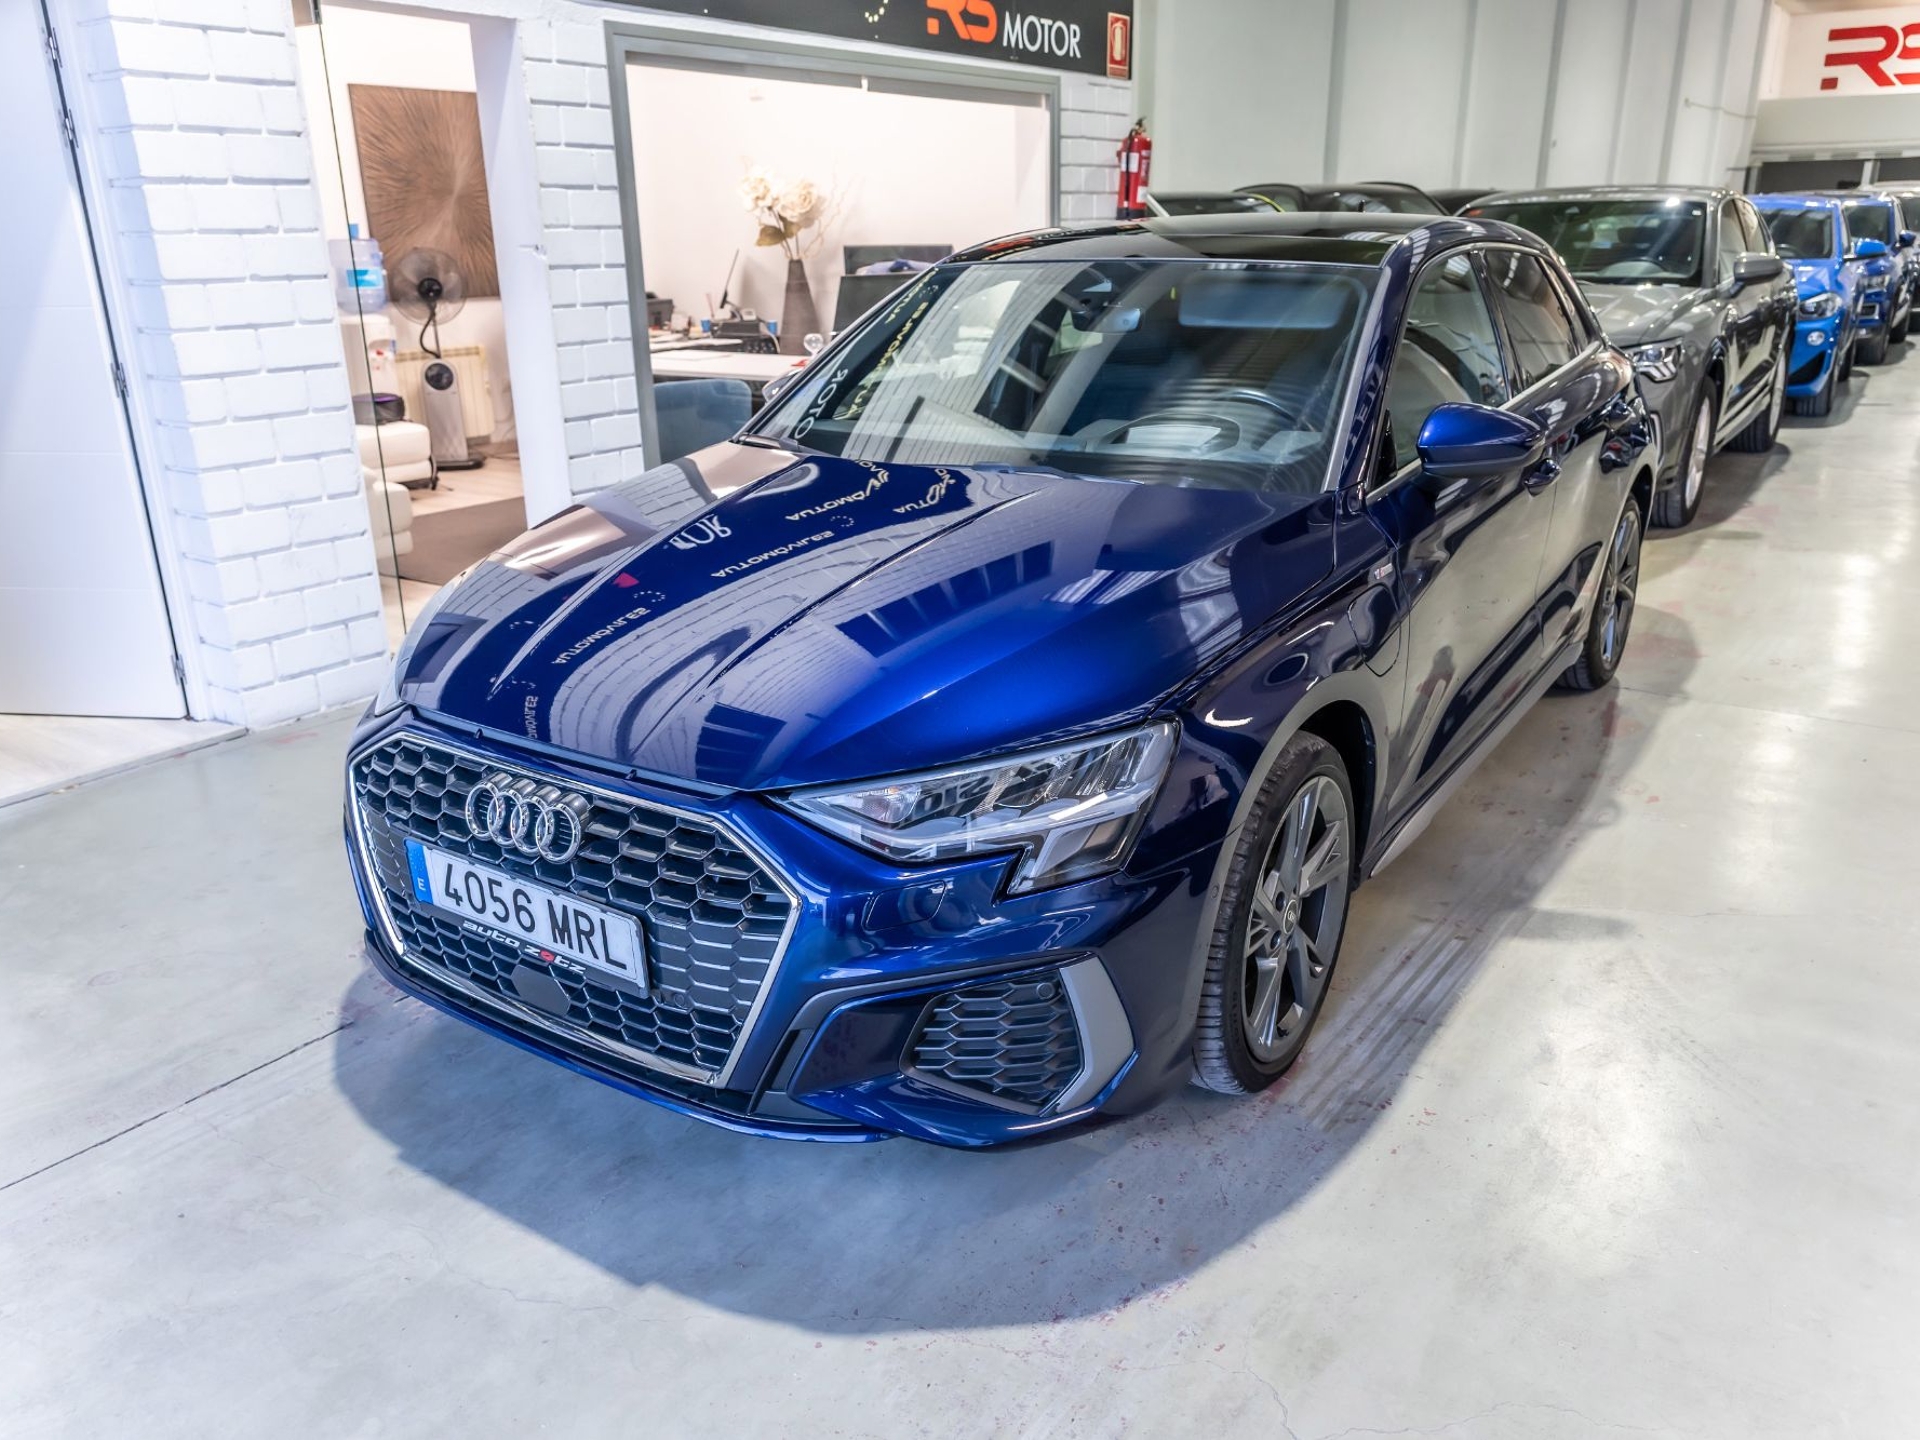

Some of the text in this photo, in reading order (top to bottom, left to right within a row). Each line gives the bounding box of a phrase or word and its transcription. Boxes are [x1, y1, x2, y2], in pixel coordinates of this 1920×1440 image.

[1002, 11, 1082, 59] MOTOR
[417, 878, 426, 891] E
[444, 863, 628, 970] 4056 MRL
[462, 920, 521, 948] auto
